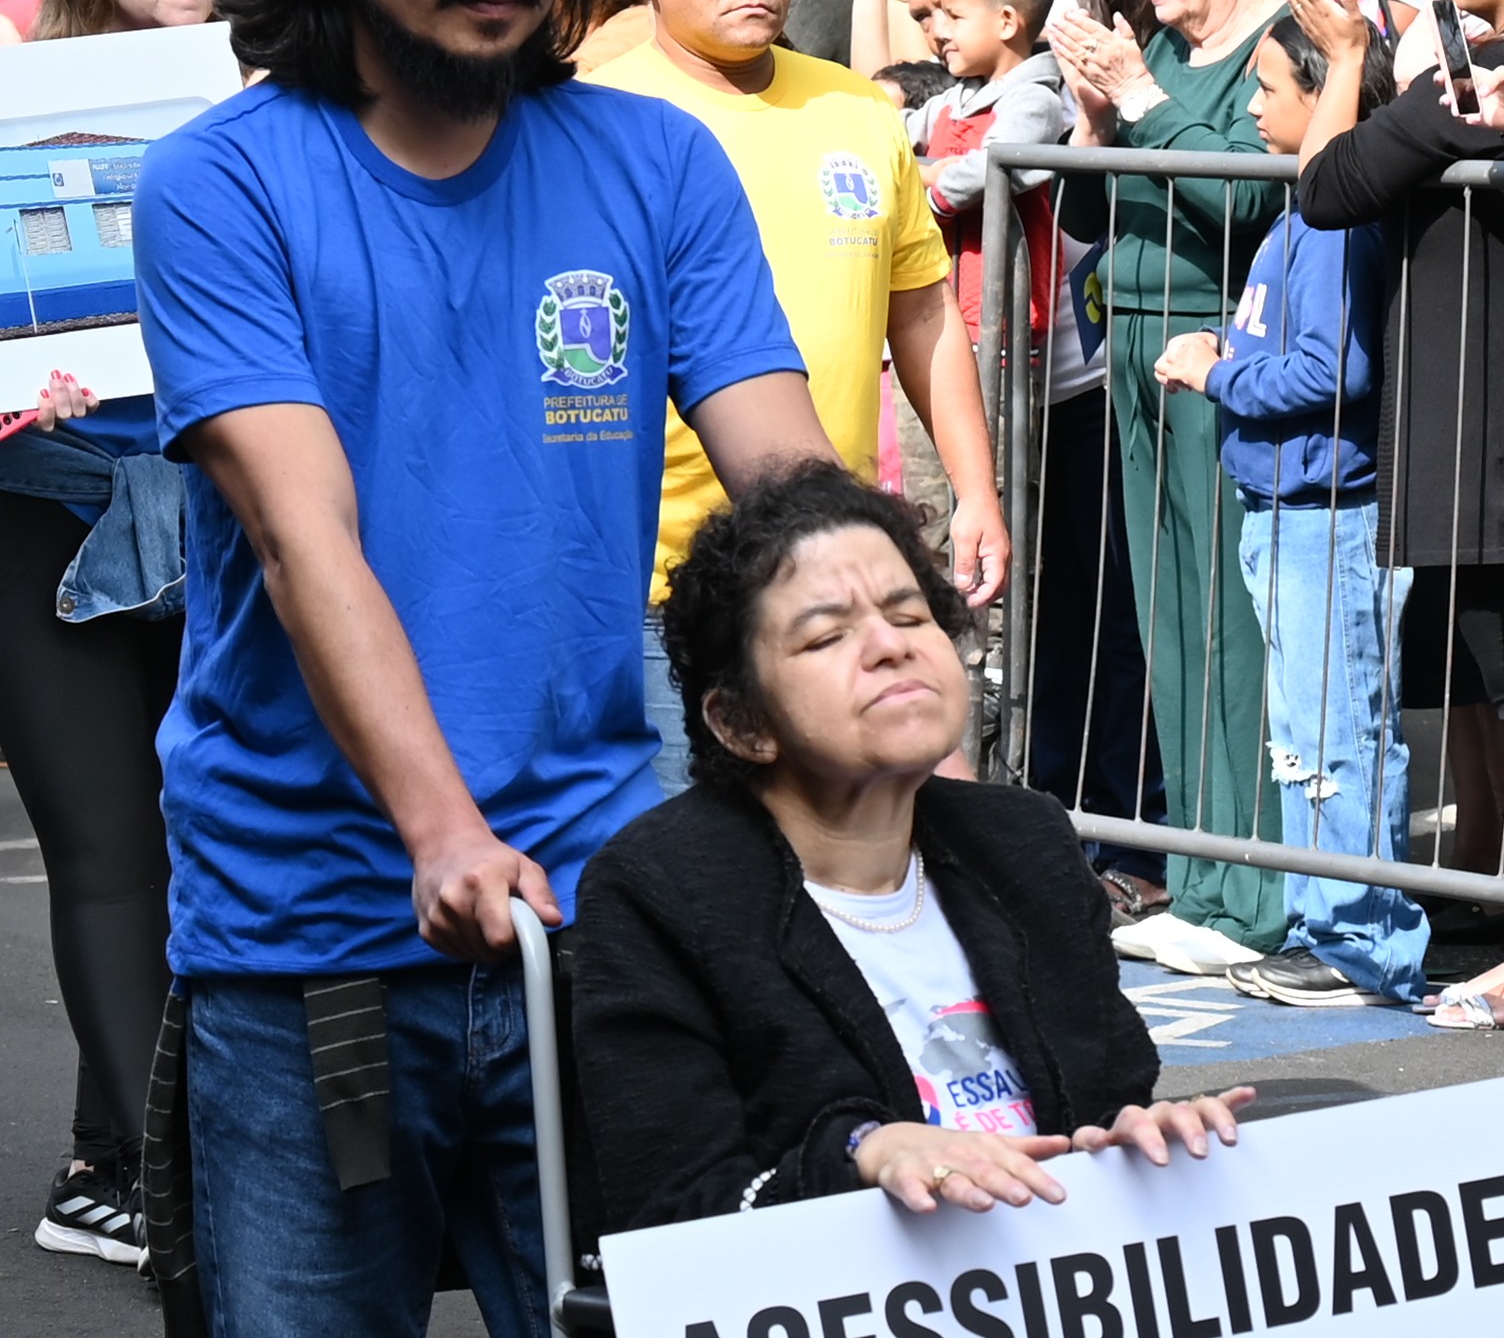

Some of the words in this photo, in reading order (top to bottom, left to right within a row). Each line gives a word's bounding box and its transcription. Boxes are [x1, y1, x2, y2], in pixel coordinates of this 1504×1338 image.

[564, 367, 613, 385] BOTUCATU
[544, 395, 615, 408] PREFEITURA
[545, 408, 628, 425] BOTUCATU
[946, 1069, 1012, 1108] ESSA
